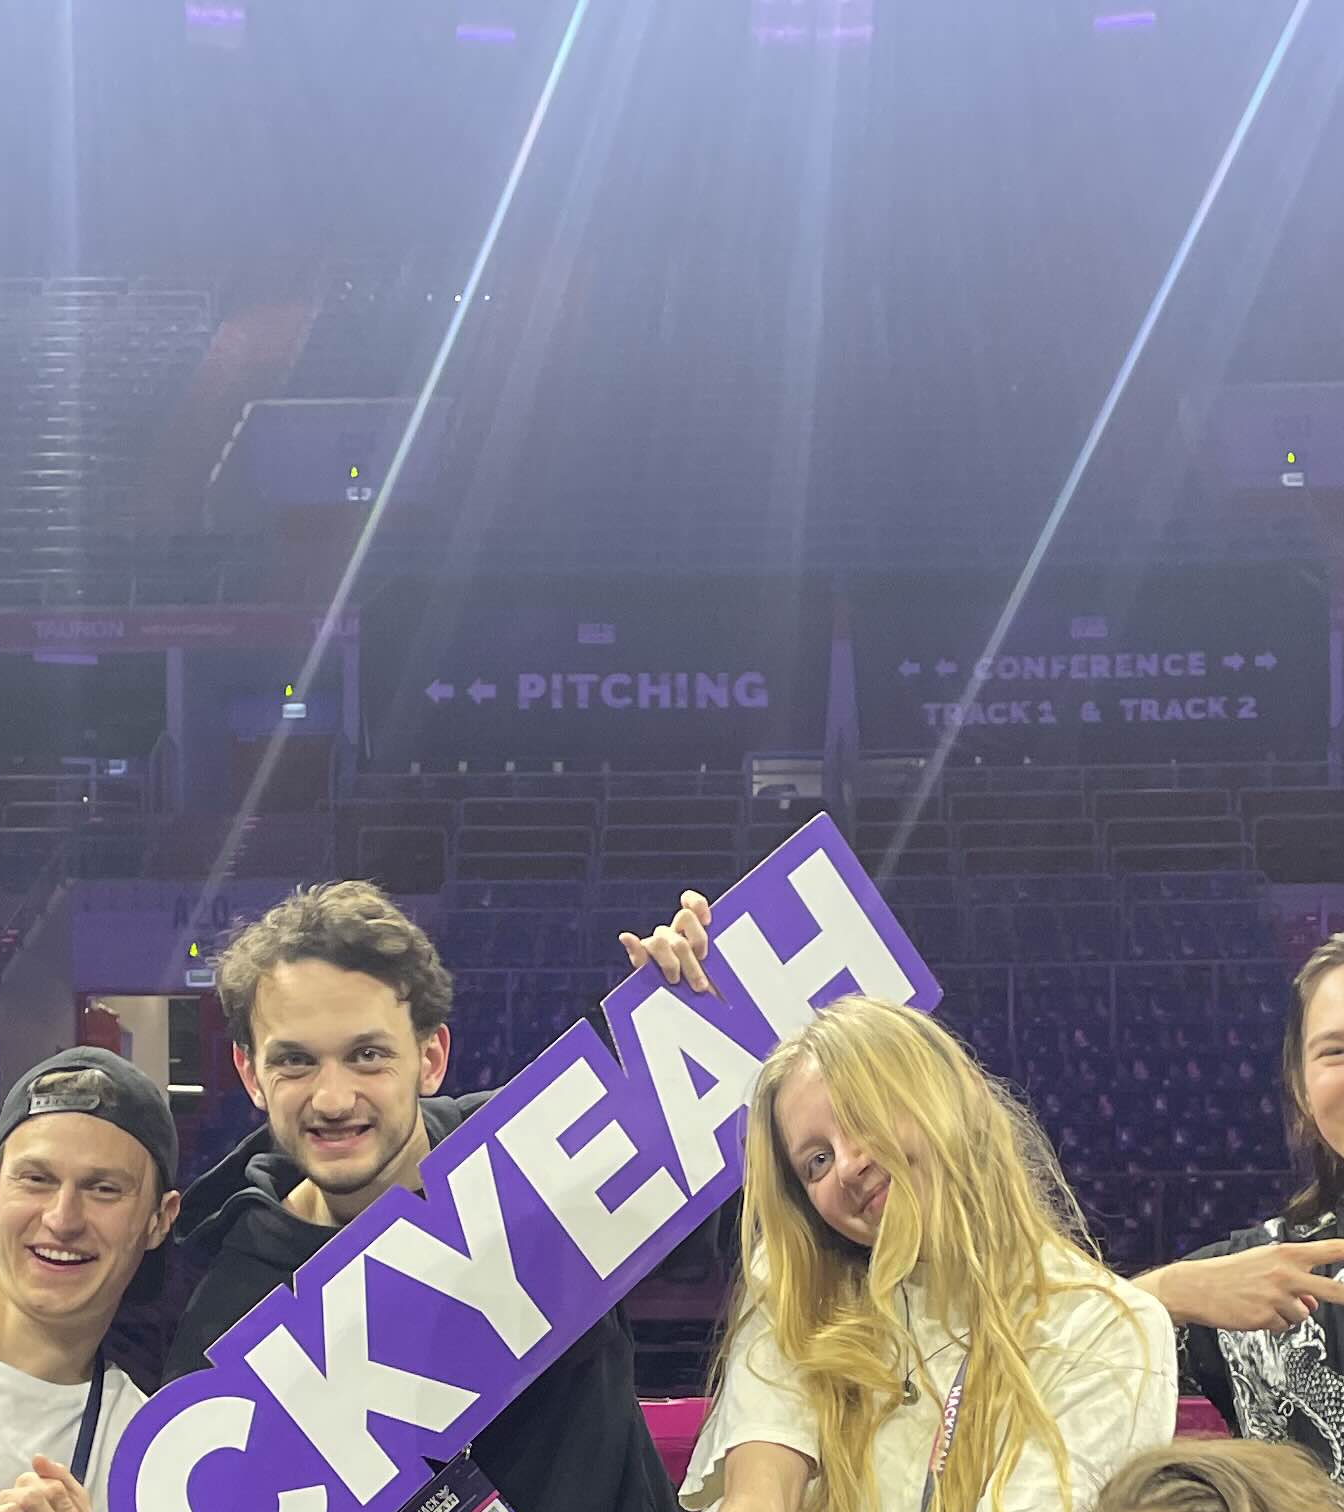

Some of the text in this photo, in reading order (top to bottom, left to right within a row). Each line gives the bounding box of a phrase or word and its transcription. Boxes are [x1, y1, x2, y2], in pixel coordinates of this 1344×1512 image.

[32, 620, 126, 640] TAURON
[973, 651, 1206, 681] CONFERENCE
[517, 671, 769, 710] PITCHING
[922, 702, 1034, 728] TRACK
[1080, 701, 1102, 724] &
[1120, 697, 1229, 722] TRACK
[1237, 696, 1258, 720] 2
[172, 896, 229, 930] A0
